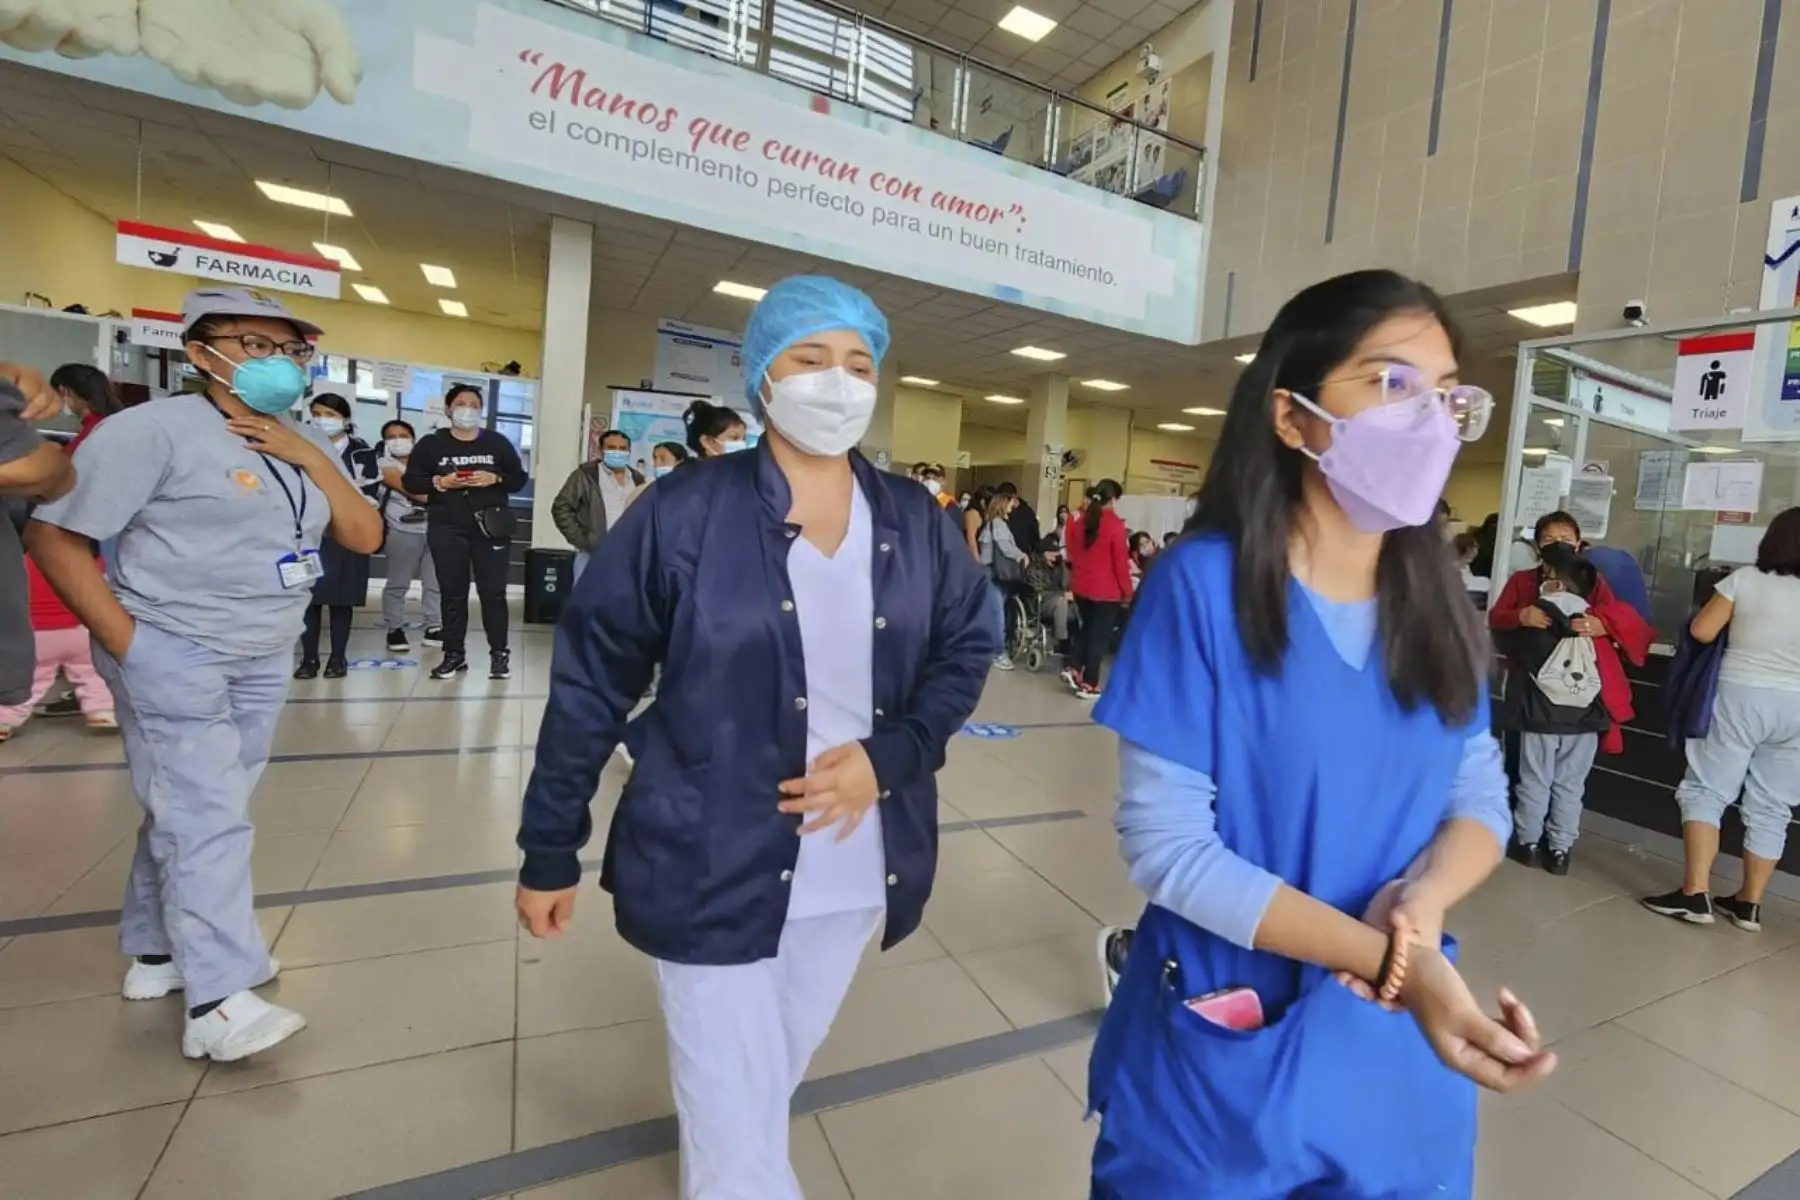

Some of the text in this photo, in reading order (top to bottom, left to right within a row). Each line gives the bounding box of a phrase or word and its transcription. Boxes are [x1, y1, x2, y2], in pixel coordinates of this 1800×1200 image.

[518, 49, 678, 133] “Manos
[688, 116, 751, 153] que
[762, 139, 860, 185] curan
[869, 171, 924, 204] con
[528, 110, 1118, 287] el complemento perfecto para un buen tratamiento.
[195, 255, 314, 288] FARMACIA
[1691, 406, 1728, 421] Triaje
